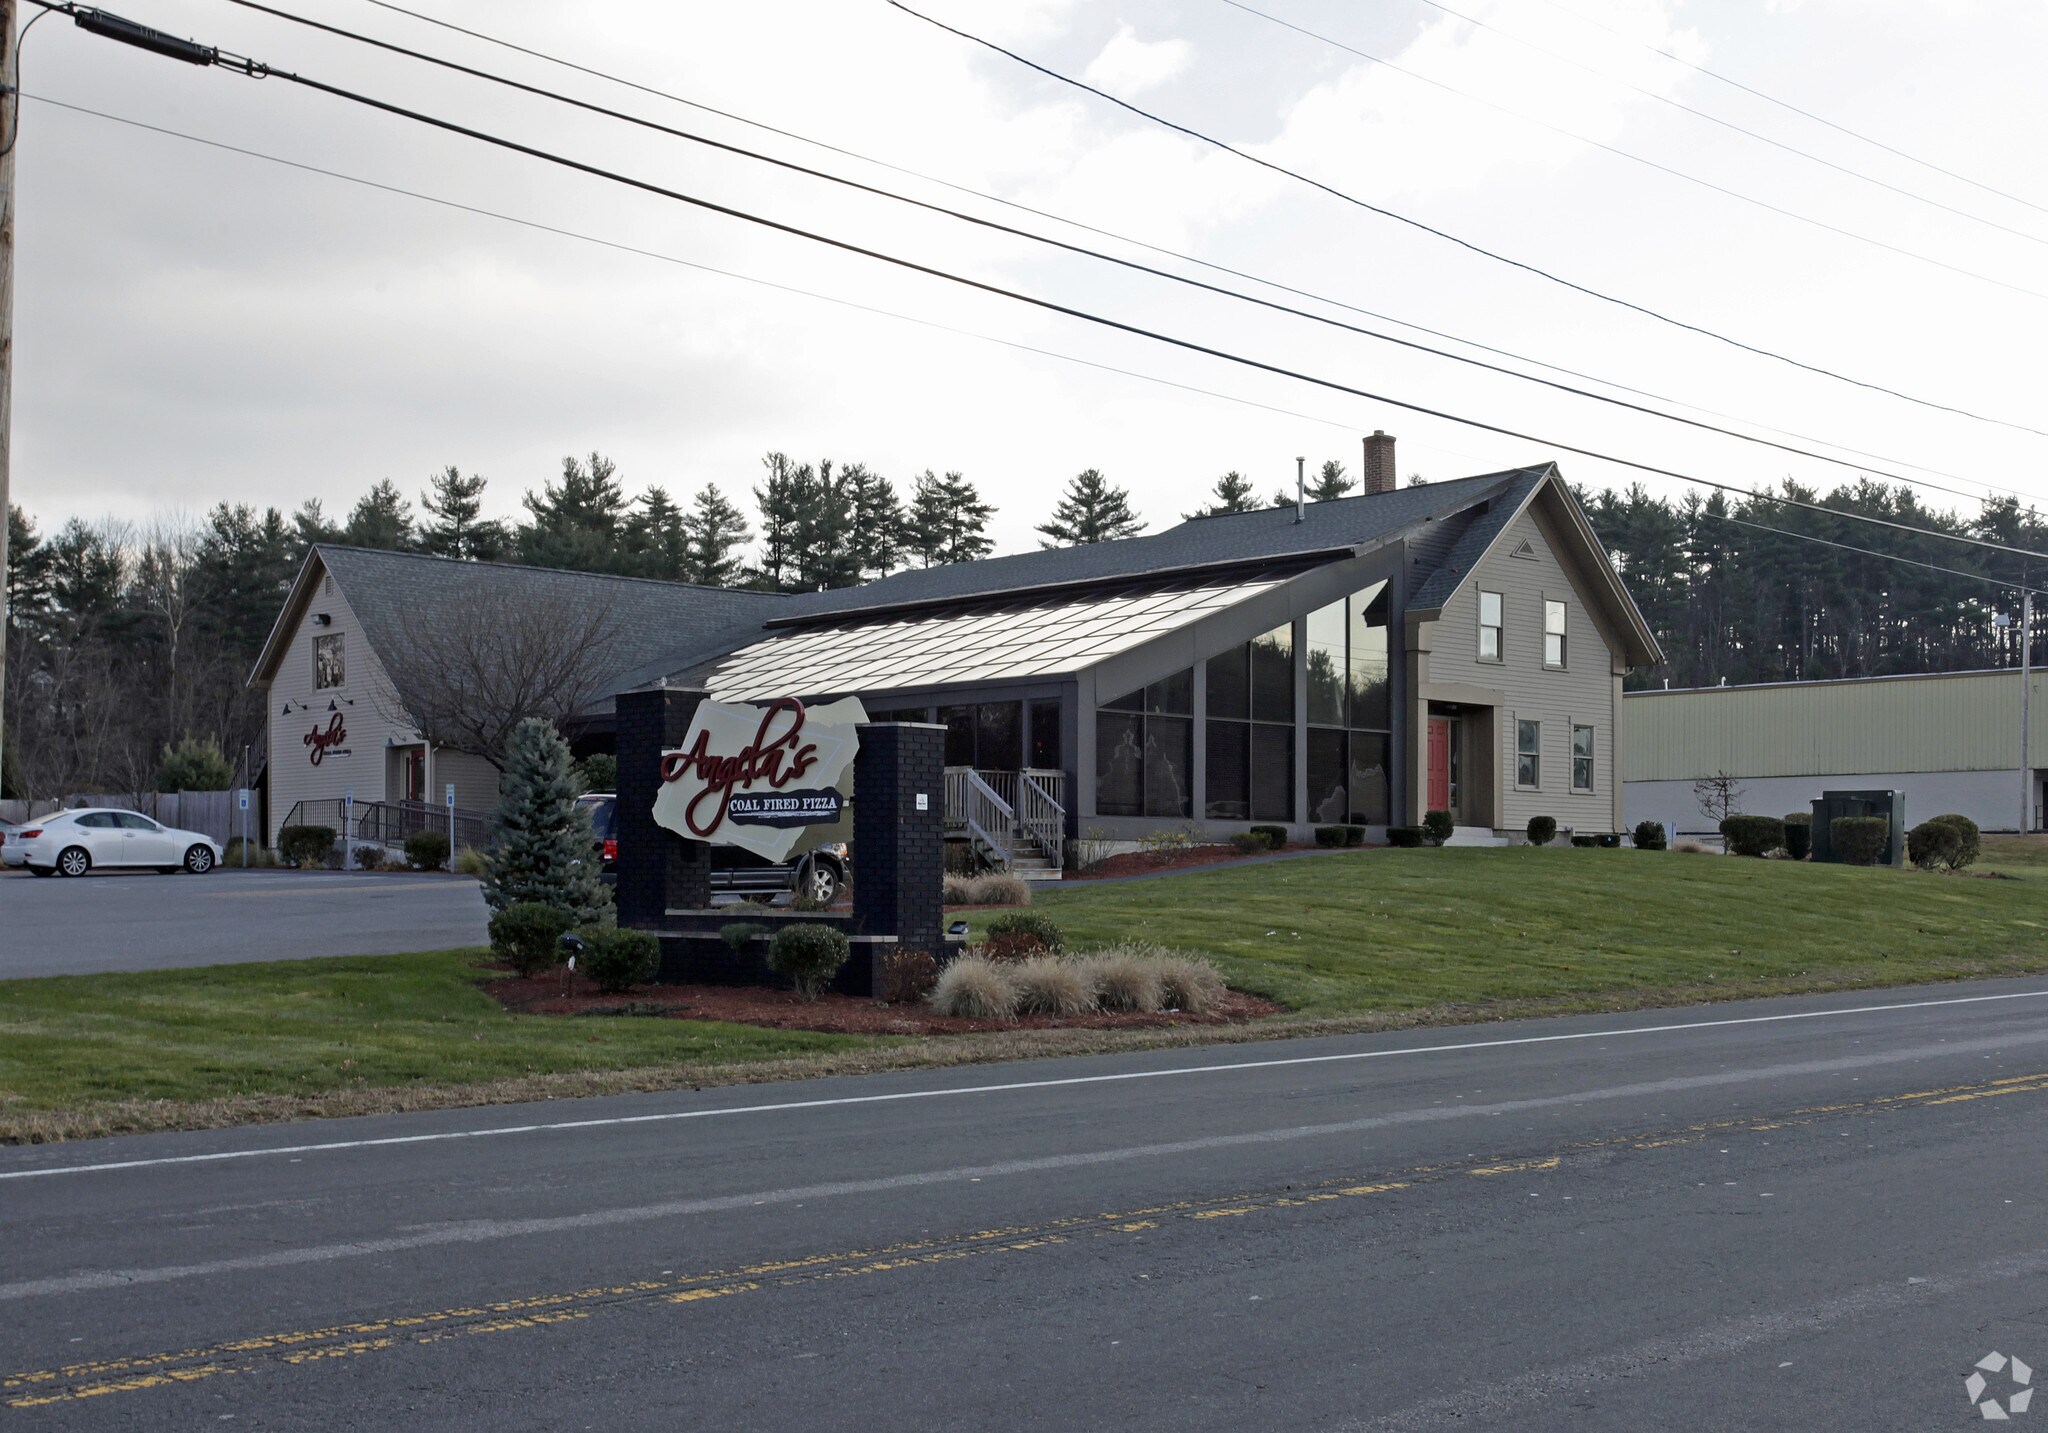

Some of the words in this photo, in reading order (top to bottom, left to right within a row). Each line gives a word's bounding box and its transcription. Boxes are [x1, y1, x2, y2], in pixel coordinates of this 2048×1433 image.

[661, 697, 818, 837] Angela's
[730, 799, 760, 811] COAL
[763, 798, 799, 811] FIRED
[802, 797, 837, 809] PIZZA
